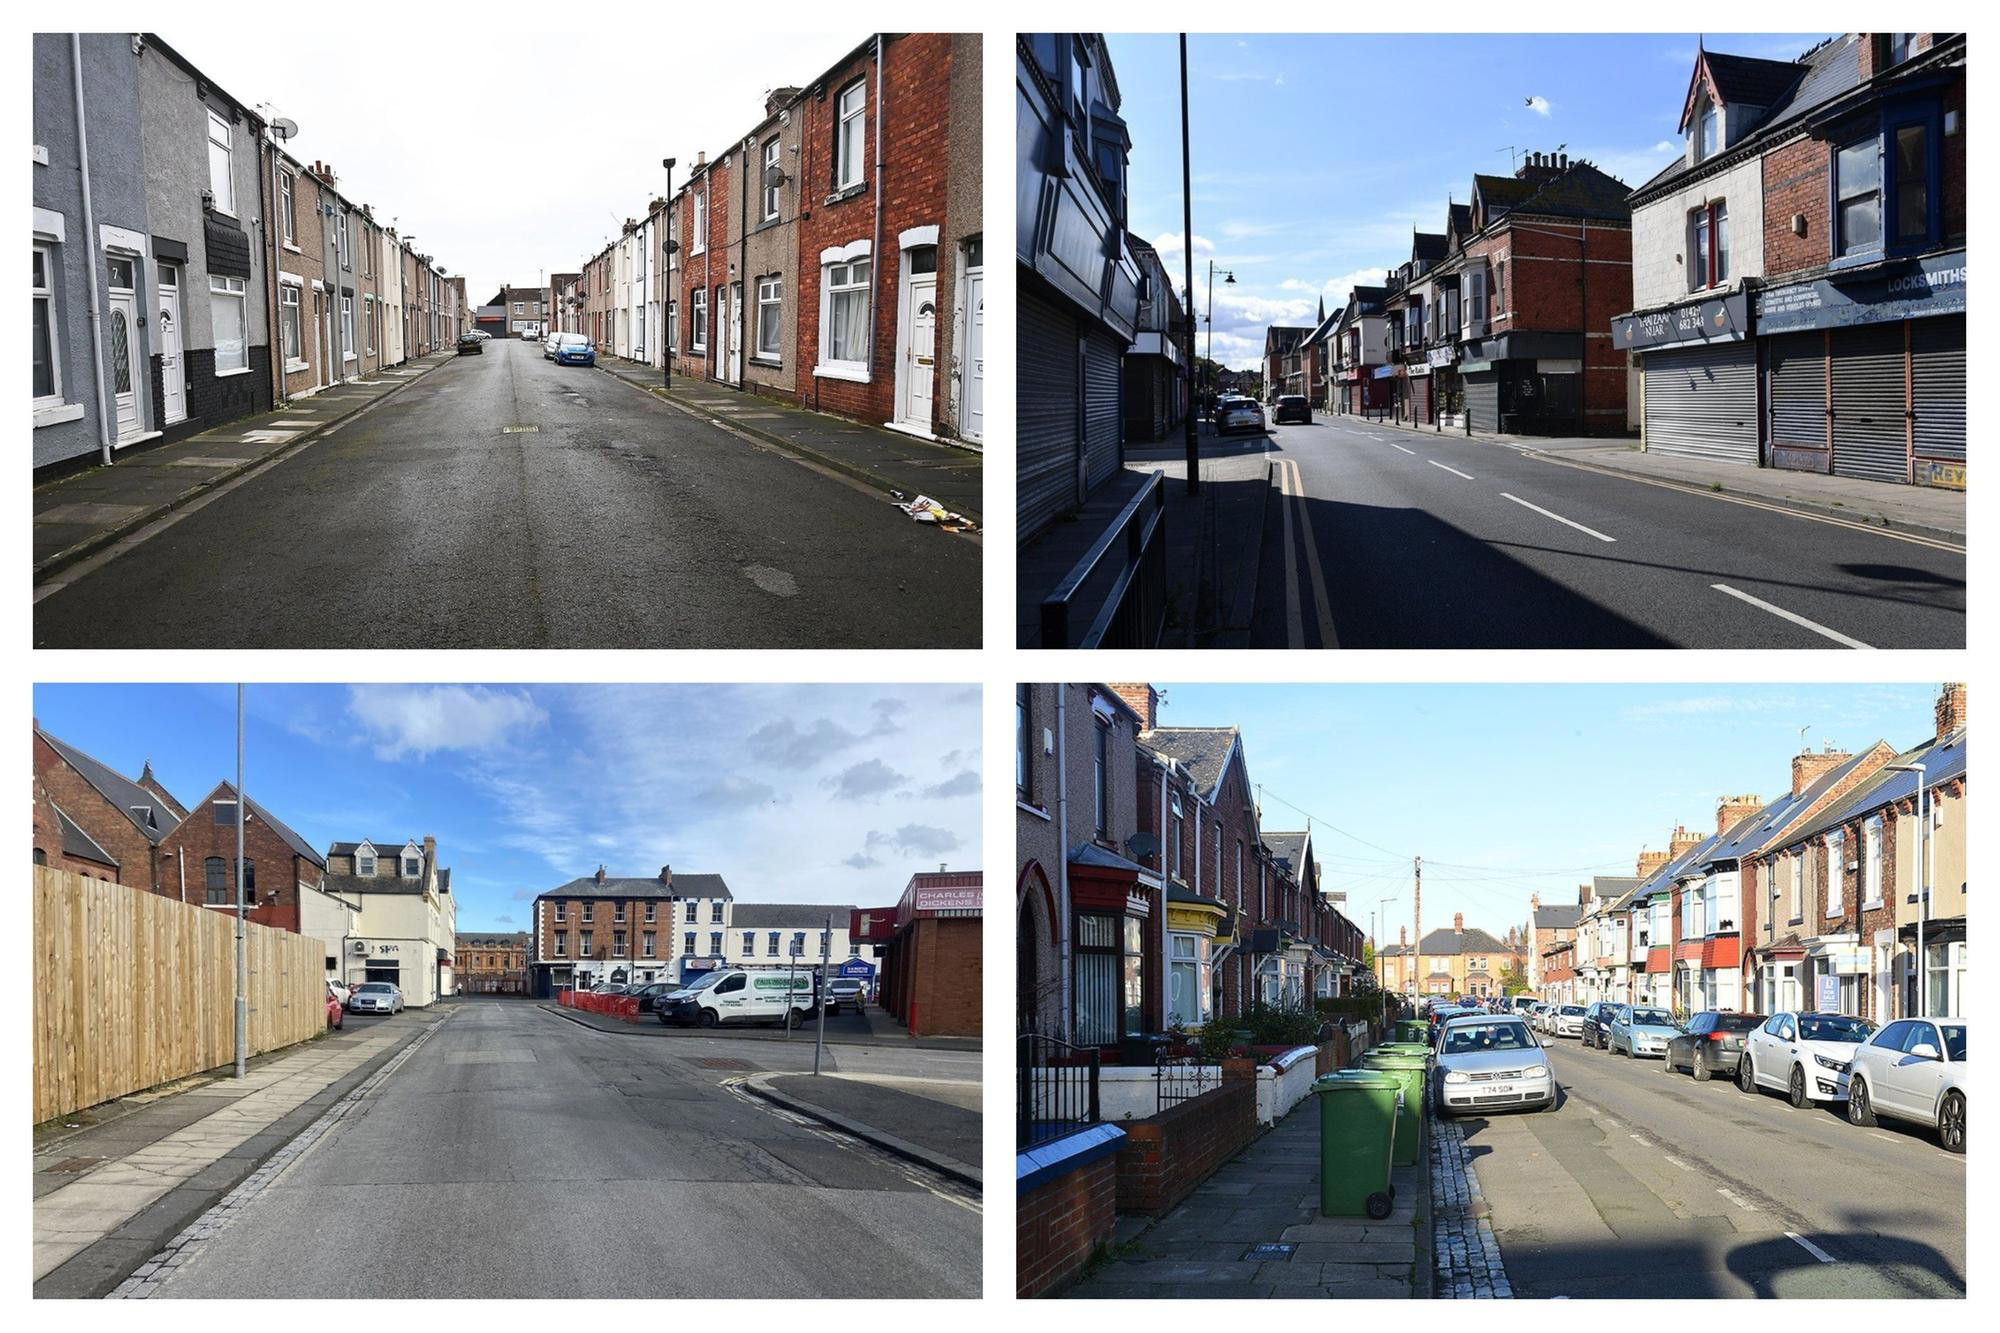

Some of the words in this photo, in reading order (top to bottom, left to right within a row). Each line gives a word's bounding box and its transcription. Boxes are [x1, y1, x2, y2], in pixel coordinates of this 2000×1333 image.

[112, 267, 119, 280] 7
[1888, 267, 1966, 292] LOCKSMITHS
[1784, 295, 1793, 303] AND
[1679, 319, 1691, 330] 682
[1692, 316, 1704, 328] 343
[919, 891, 975, 900] CHARLES
[920, 898, 974, 908] DICKENS
